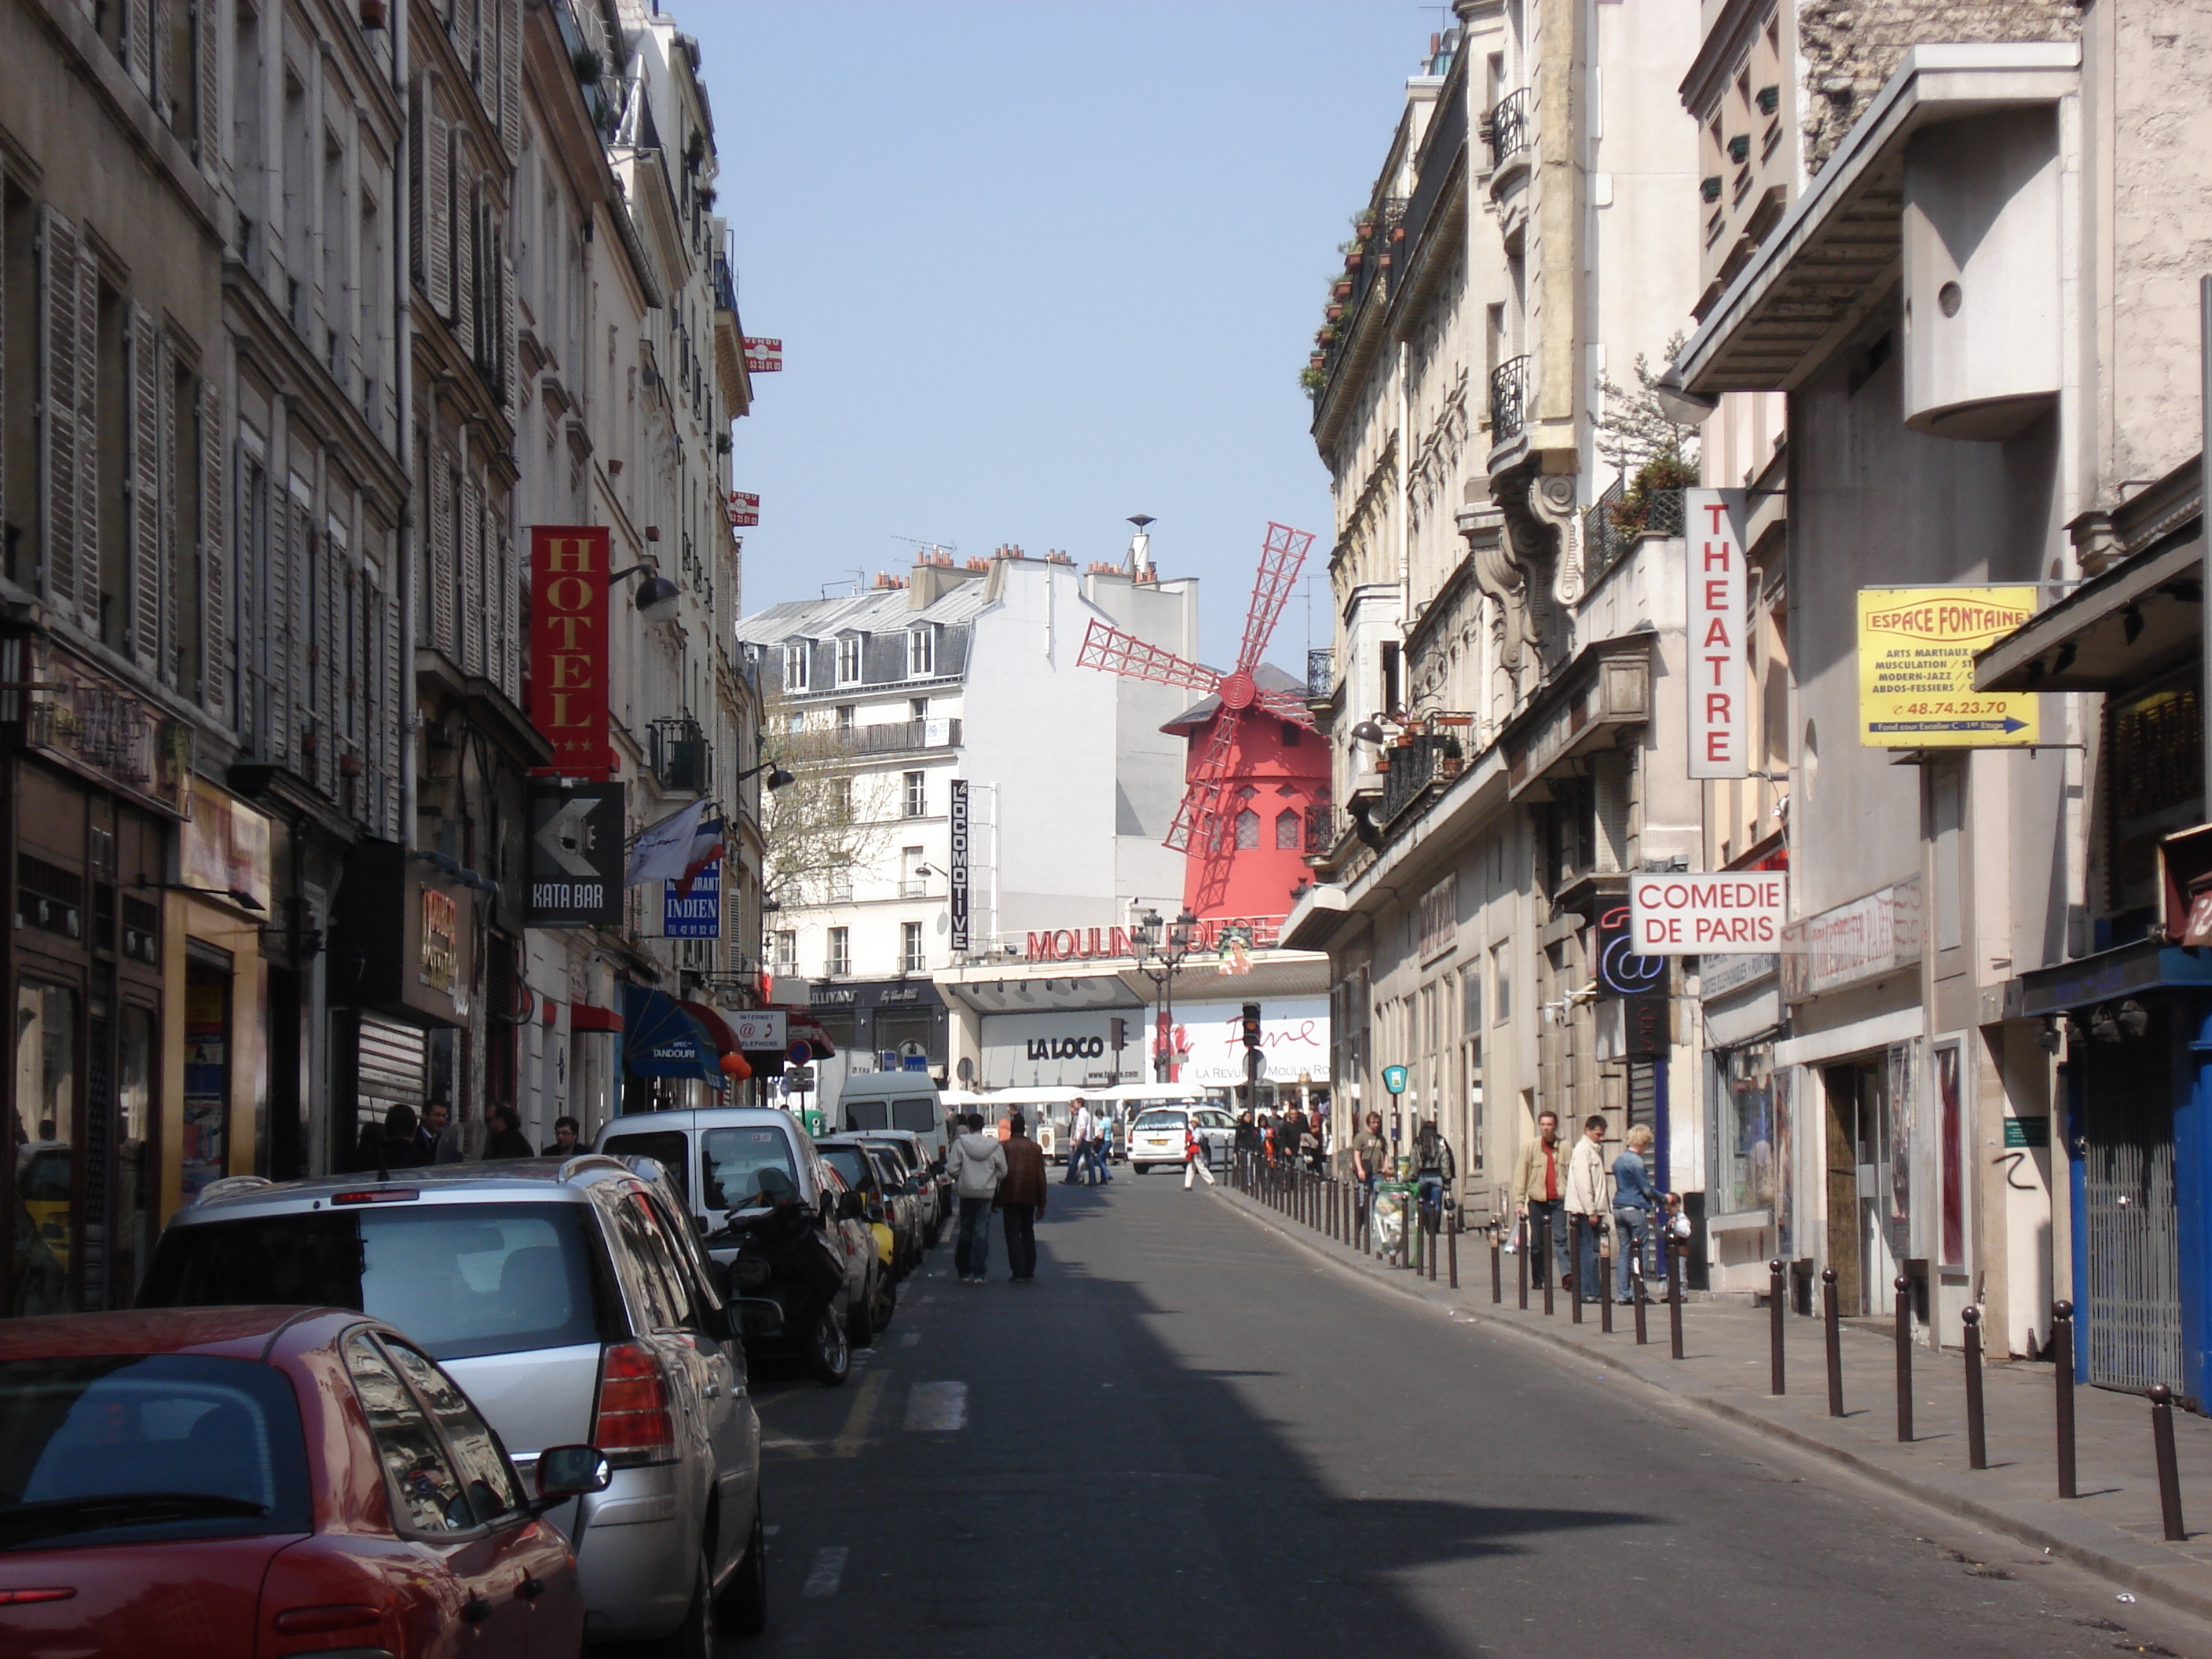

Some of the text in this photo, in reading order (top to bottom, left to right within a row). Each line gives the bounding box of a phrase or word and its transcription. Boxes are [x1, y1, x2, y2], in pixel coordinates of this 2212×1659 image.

[744, 337, 778, 346] VENDU
[730, 491, 757, 500] ENDU
[1872, 606, 2024, 635] ESPACE FONTAINE
[544, 537, 596, 727] HOTEL
[1704, 504, 1731, 762] THEATRE
[1886, 648, 1968, 657] ARTS MARTIAUX
[1876, 661, 1947, 670] MUSCULATION
[1878, 672, 1952, 681] MODERN-JAZZ
[1873, 683, 1954, 693] ABDOS-FESSIERS
[1907, 701, 2007, 715] 48.74.23.70
[1878, 722, 1898, 731] Fond
[1920, 721, 1950, 731] Escalier
[1981, 720, 2004, 731] Etage
[953, 786, 967, 948] LOCOMOTIVE
[533, 884, 602, 908] KATA BAR
[1636, 883, 1780, 909] COMEDIE
[667, 899, 717, 918] INDIEN
[1646, 918, 1683, 943] DE
[1696, 916, 1774, 943] PARIS
[1027, 917, 1269, 962] MOULIN OUE
[653, 1049, 695, 1058] TANDOURI
[1027, 1036, 1104, 1060] LA LOCO
[1196, 1068, 1210, 1079] LA
[1268, 1064, 1310, 1076] MOULIN
